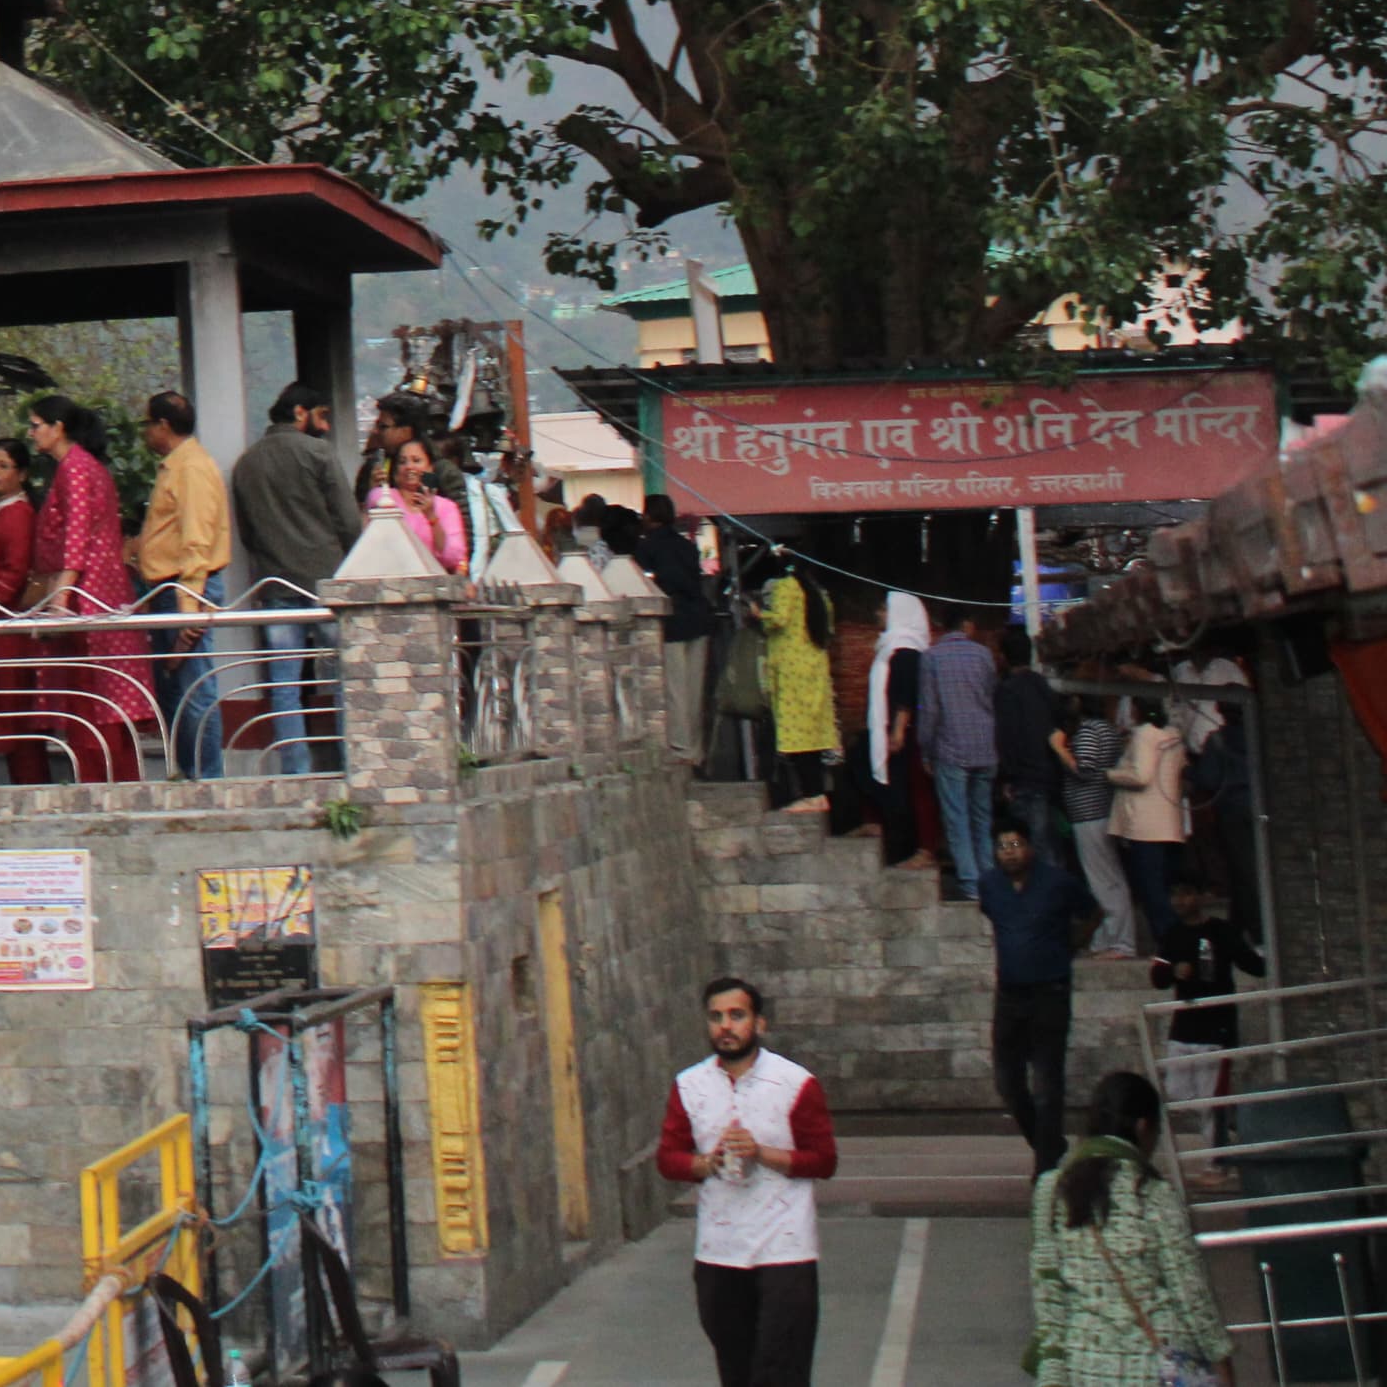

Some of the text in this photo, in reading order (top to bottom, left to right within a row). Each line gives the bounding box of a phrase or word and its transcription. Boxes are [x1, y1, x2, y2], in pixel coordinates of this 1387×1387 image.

[673, 391, 1266, 475] श्री हनुमंत एवं श्री शनि देव मन्दिर
[809, 476, 894, 501] विश्वनाथ
[898, 473, 953, 499] मन्दिर
[1028, 466, 1125, 494] उत्तरकाशी
